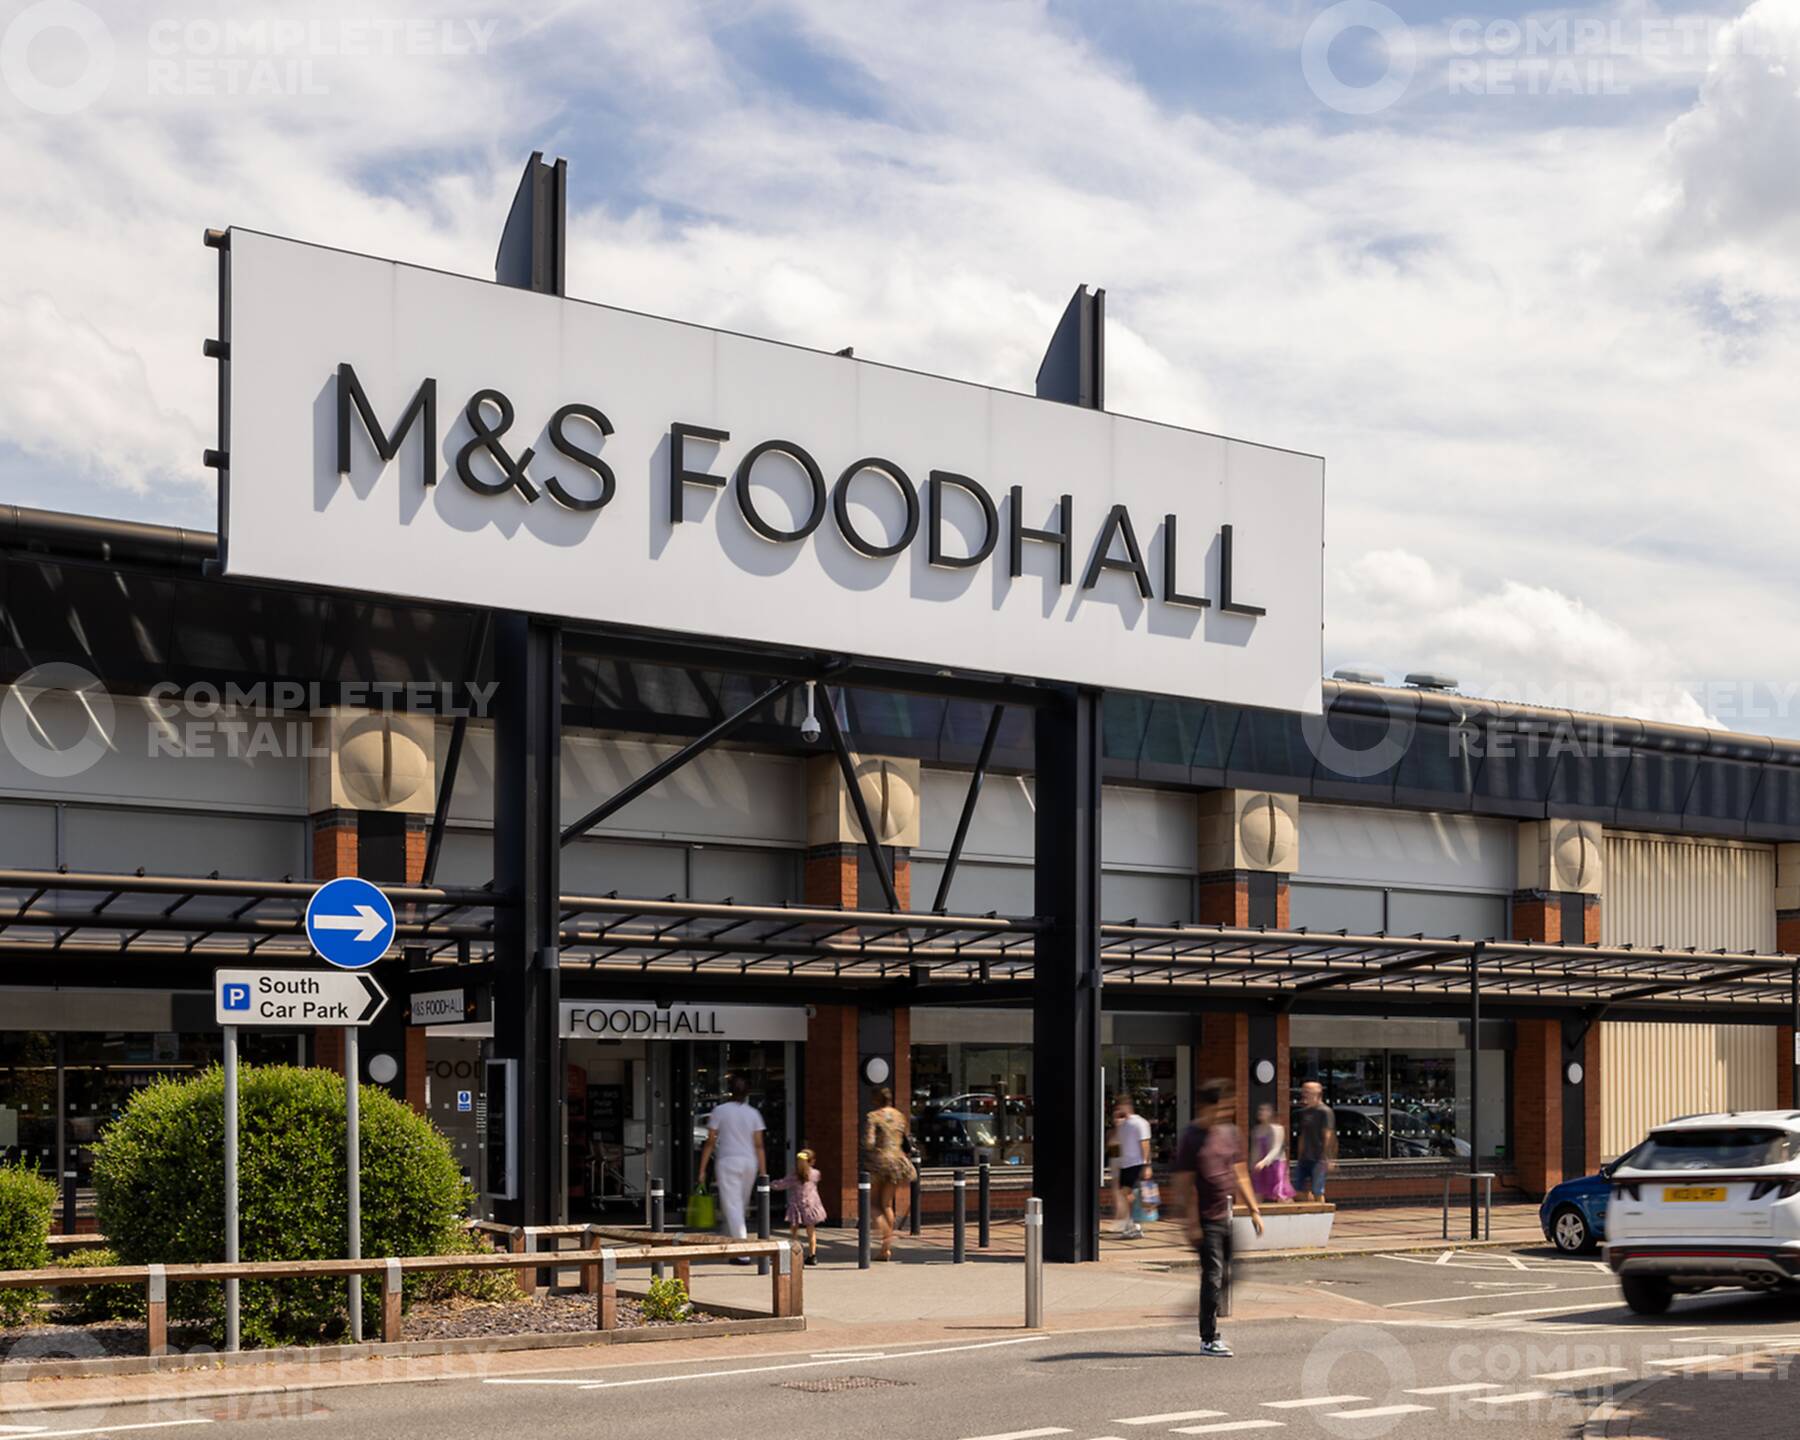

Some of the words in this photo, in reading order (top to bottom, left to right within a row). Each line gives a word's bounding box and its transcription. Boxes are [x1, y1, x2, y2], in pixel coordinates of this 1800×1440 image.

[337, 362, 616, 512] M&S
[671, 421, 1266, 616] FOODHALL
[259, 976, 320, 994] South
[229, 988, 245, 1007] P
[260, 1001, 297, 1018] Car
[303, 1002, 349, 1018] Park
[570, 1009, 725, 1034] FOODHALL
